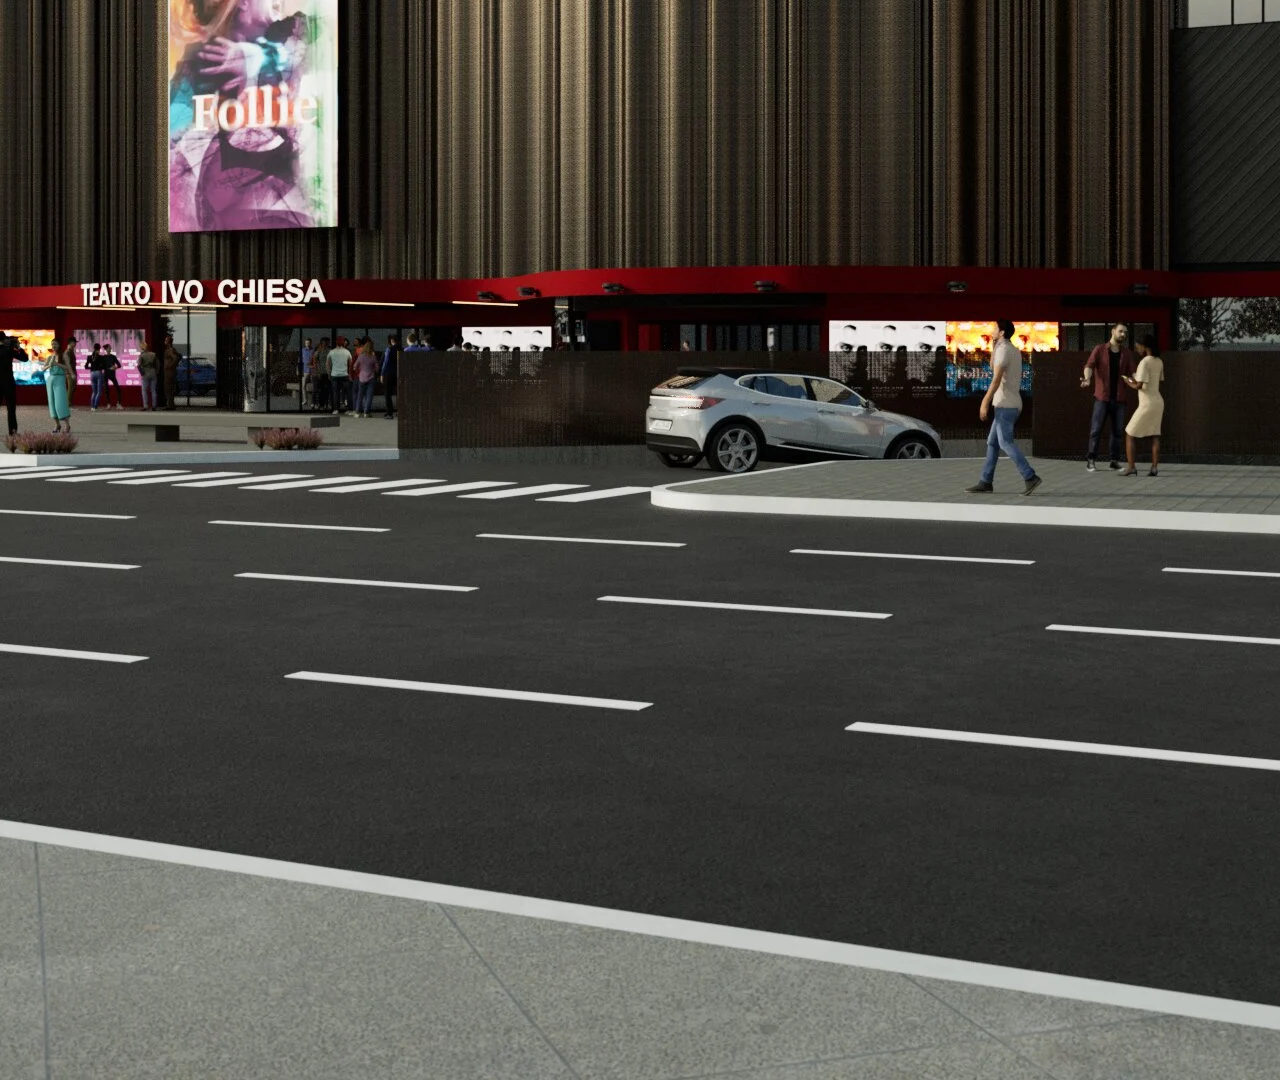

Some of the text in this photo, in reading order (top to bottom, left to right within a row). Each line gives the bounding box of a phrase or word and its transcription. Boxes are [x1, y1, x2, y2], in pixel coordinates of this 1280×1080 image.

[192, 81, 318, 132] Follie
[81, 278, 327, 306] TEATRO IVO CHIESA
